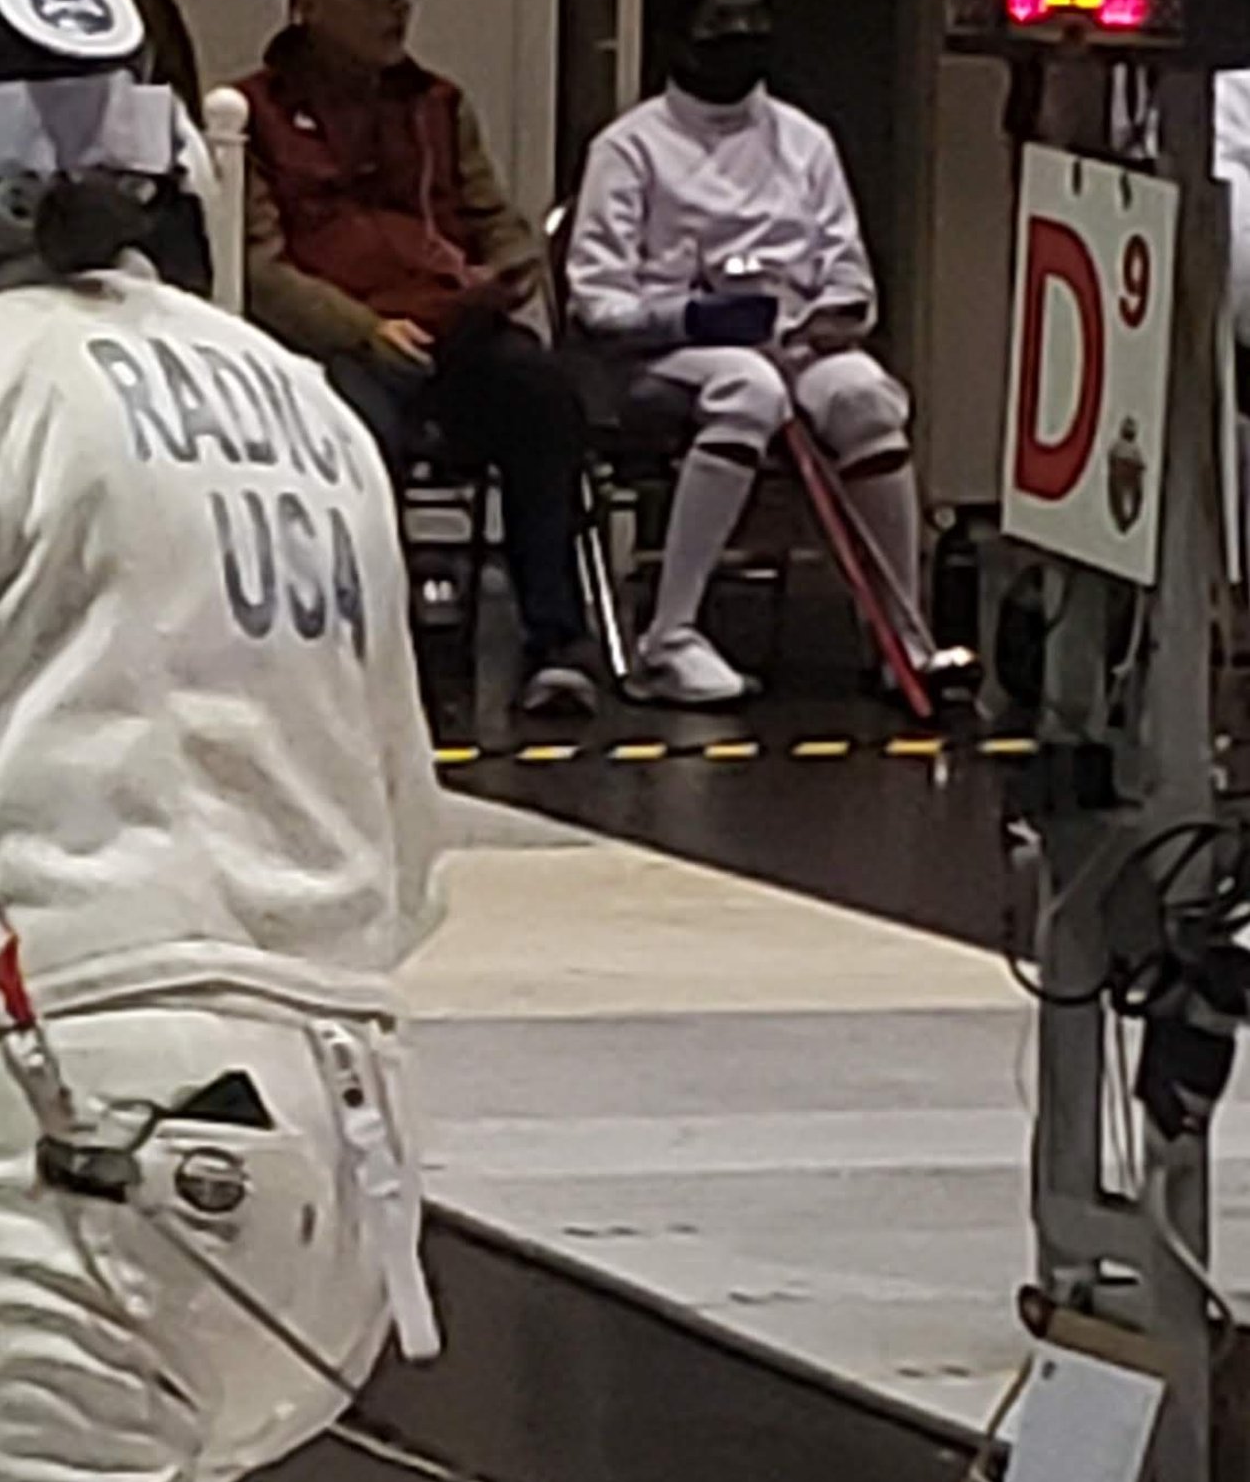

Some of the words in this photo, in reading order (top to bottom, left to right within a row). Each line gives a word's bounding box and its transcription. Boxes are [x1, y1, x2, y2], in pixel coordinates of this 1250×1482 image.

[1015, 215, 1105, 502] D
[1119, 233, 1152, 329] 9
[209, 490, 368, 663] USA
